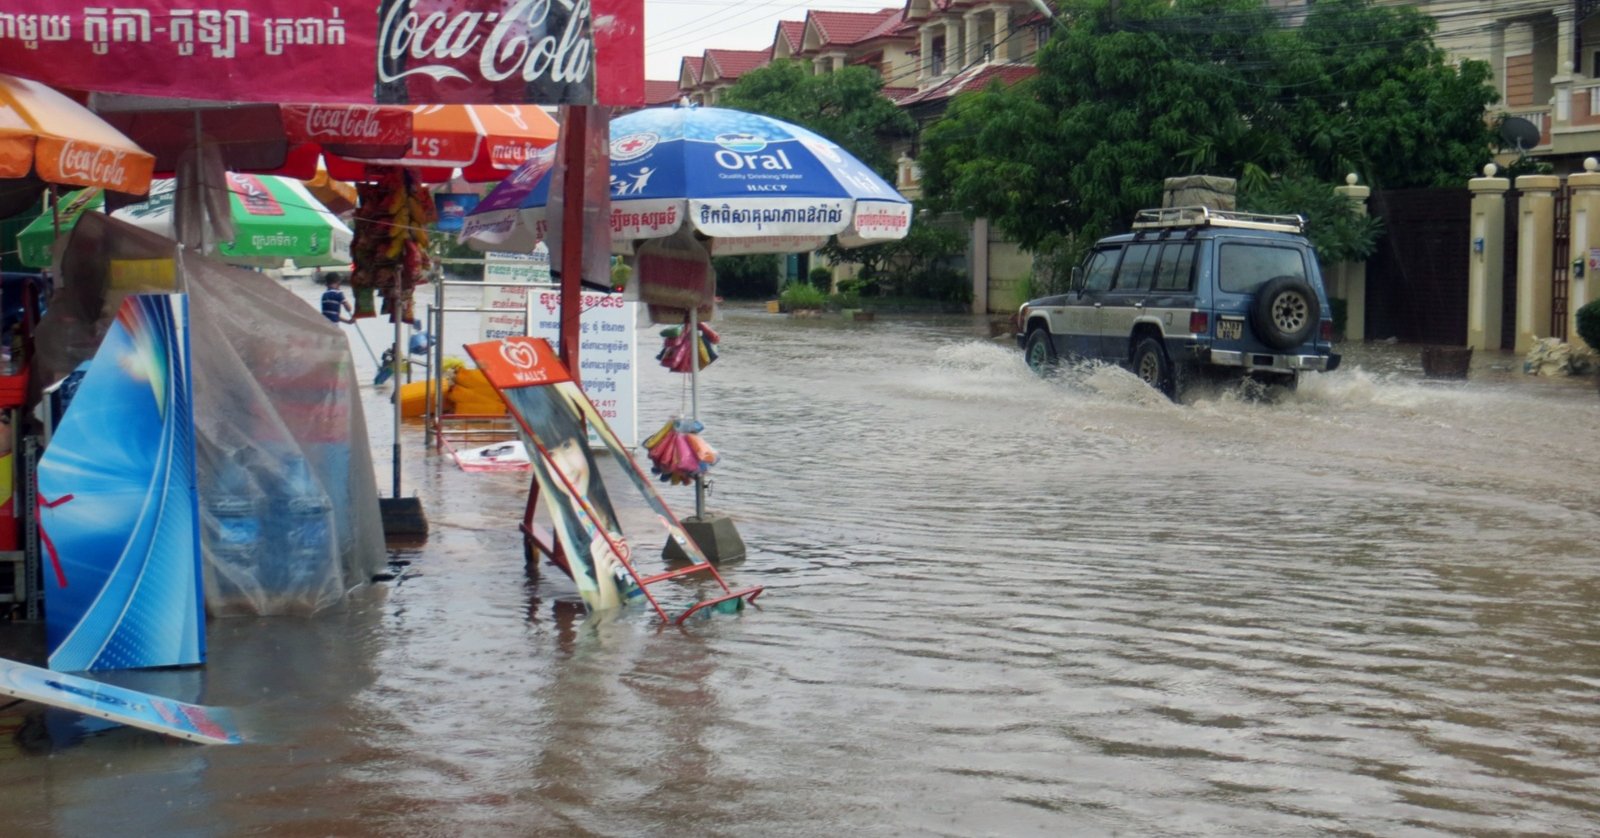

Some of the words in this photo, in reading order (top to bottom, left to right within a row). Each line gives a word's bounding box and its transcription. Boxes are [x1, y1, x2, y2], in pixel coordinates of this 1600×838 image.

[377, 0, 591, 84] Coca-Cola
[411, 136, 440, 157] L'S
[714, 148, 793, 171] Oral
[746, 184, 788, 192] HACCP
[602, 399, 617, 408] 417
